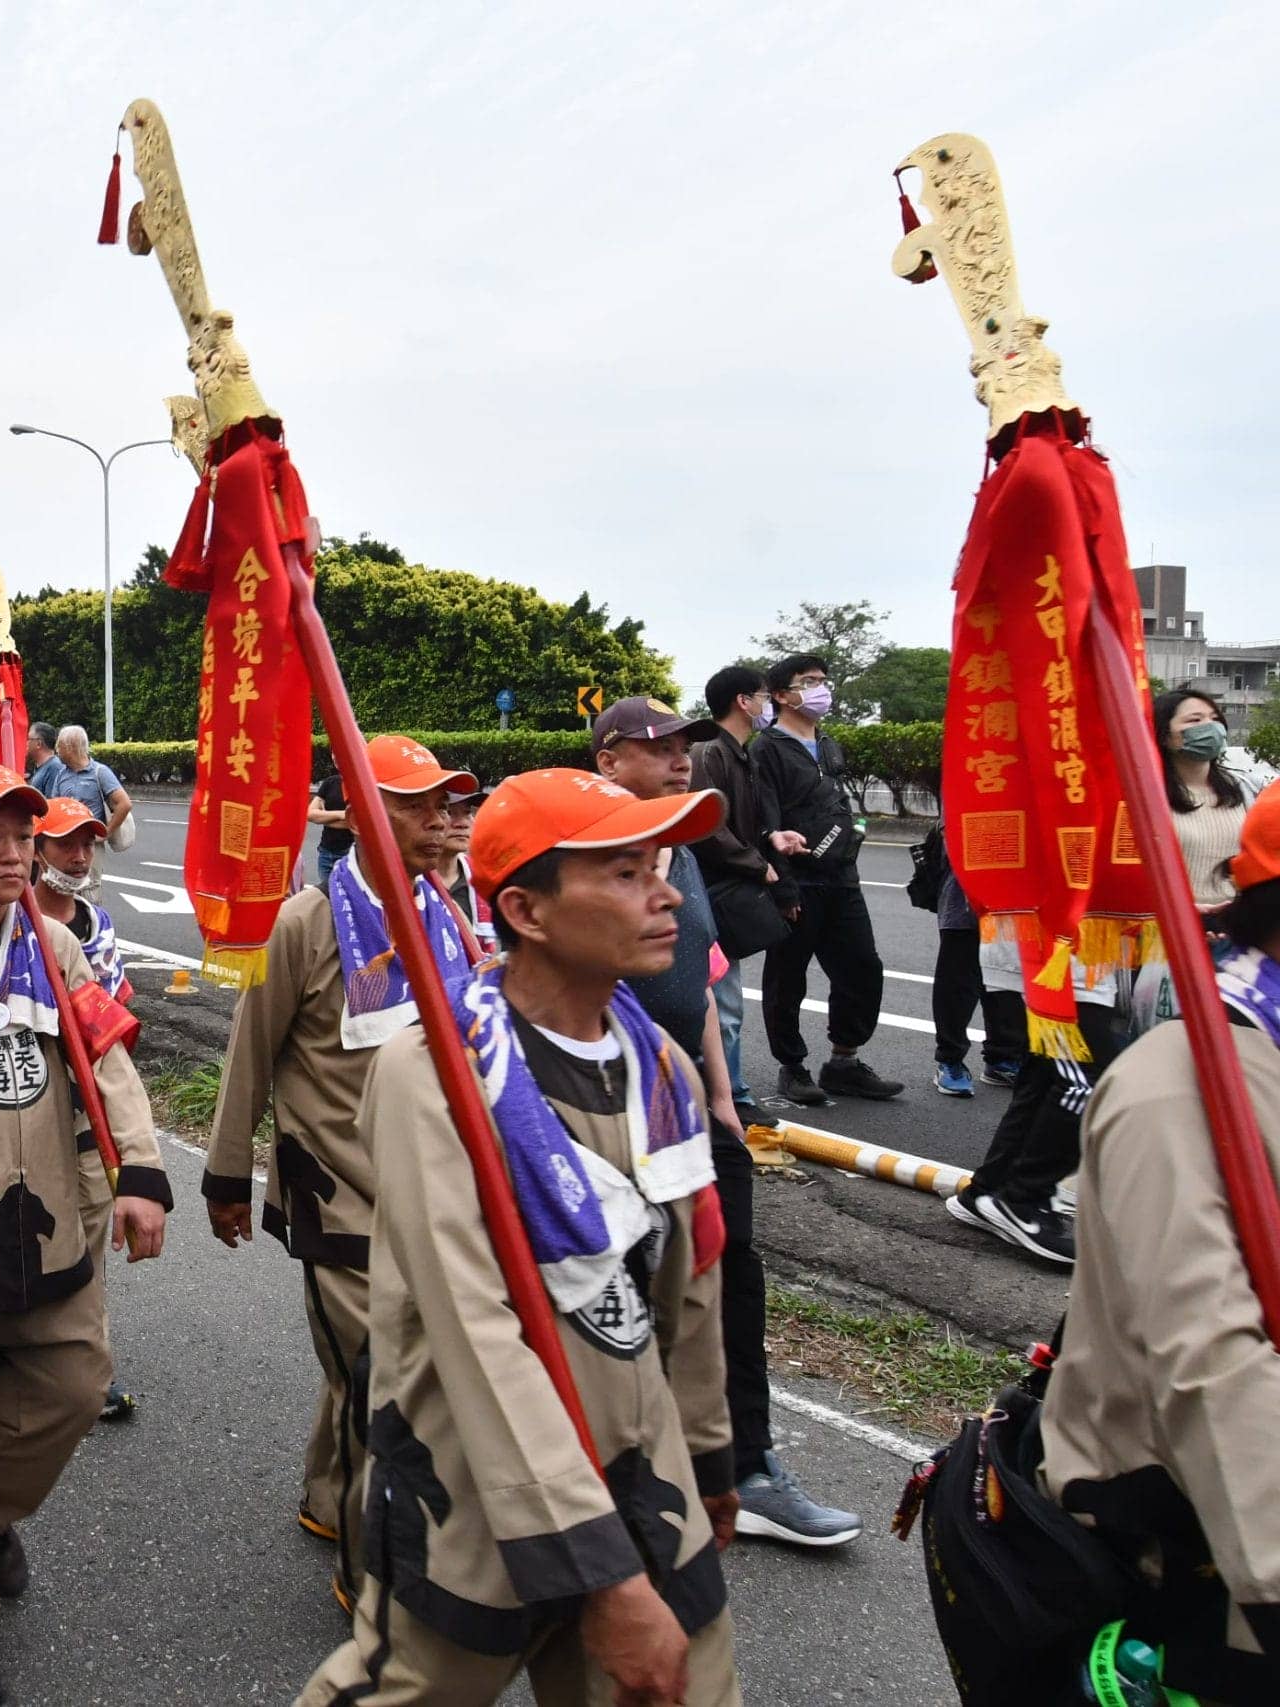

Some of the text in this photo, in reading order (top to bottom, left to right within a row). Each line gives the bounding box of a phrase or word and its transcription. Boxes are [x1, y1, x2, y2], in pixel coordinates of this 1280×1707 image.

[226, 547, 269, 784] 合境平安
[1034, 554, 1087, 804] 大甲鎮瀾宮
